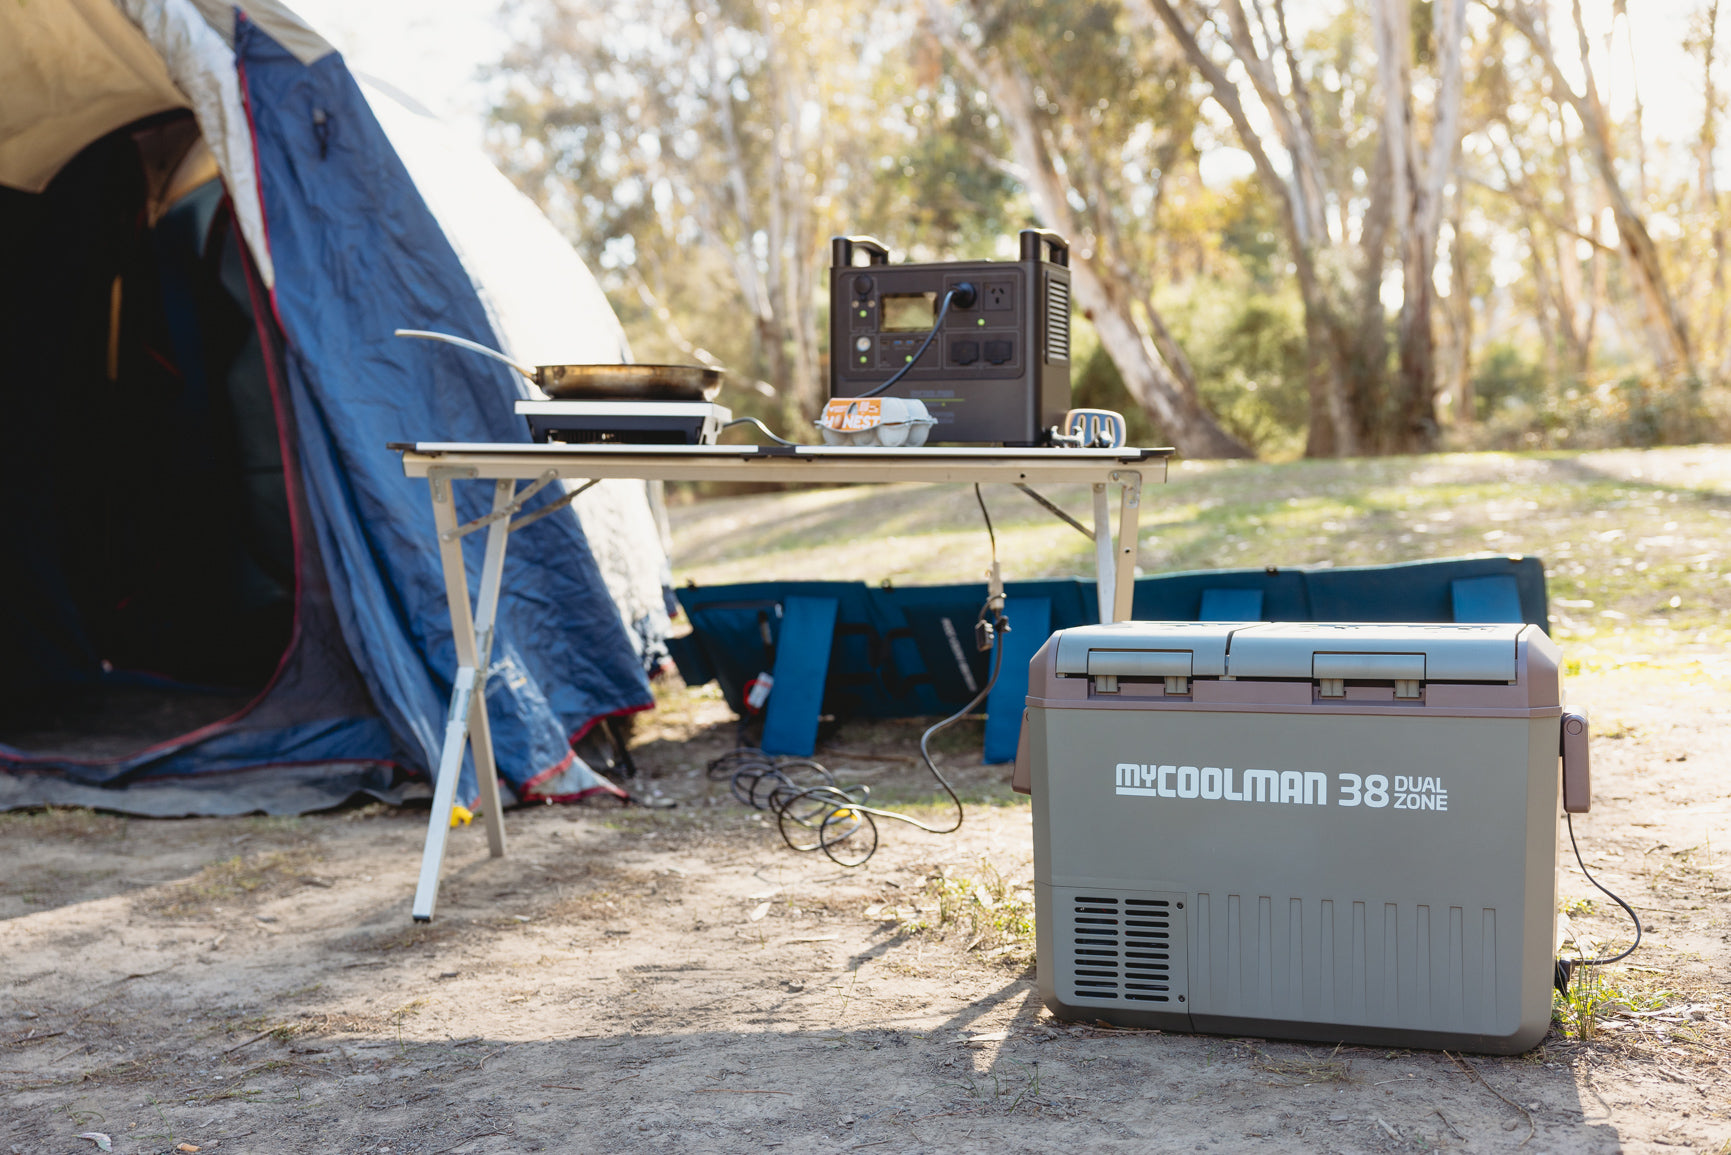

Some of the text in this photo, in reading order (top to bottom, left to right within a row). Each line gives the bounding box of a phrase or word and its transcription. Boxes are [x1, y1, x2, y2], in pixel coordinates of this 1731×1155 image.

[1115, 763, 1390, 808] MYCOOLMAN 38
[1394, 775, 1448, 793] DUAL
[1393, 793, 1448, 811] ZONE
